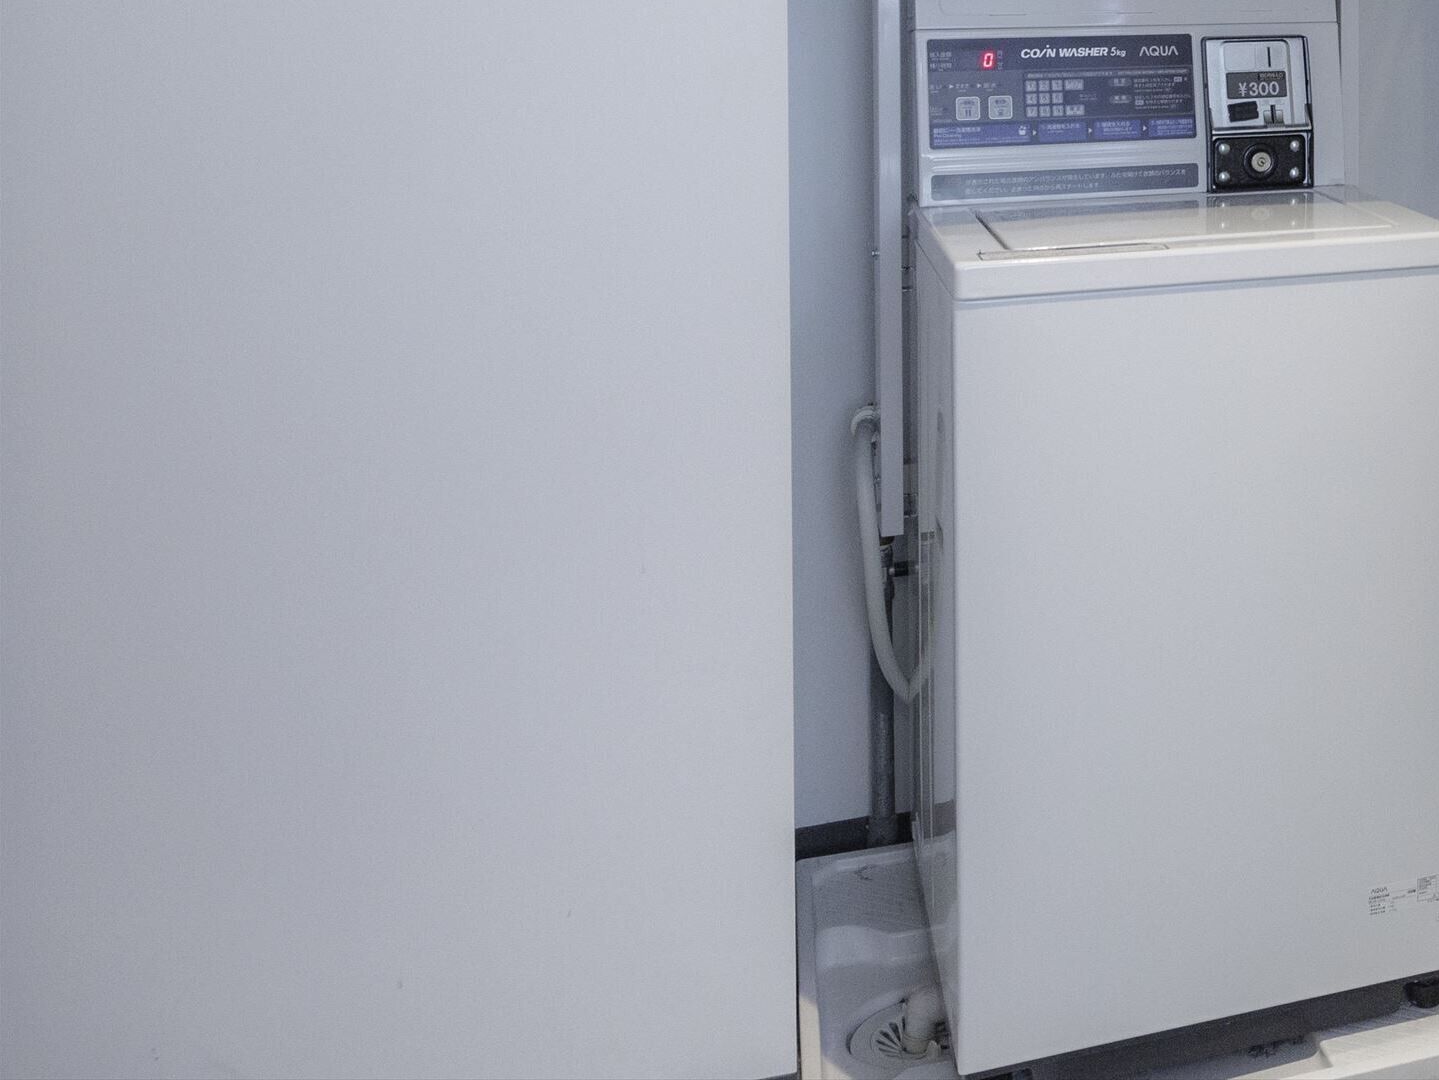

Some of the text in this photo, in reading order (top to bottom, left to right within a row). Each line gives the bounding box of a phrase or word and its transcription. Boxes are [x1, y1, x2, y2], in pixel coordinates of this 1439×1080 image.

[1020, 44, 1179, 59] COIN WASHER 5kg AQUA
[983, 52, 994, 68] 0
[1238, 81, 1280, 97] ¥300
